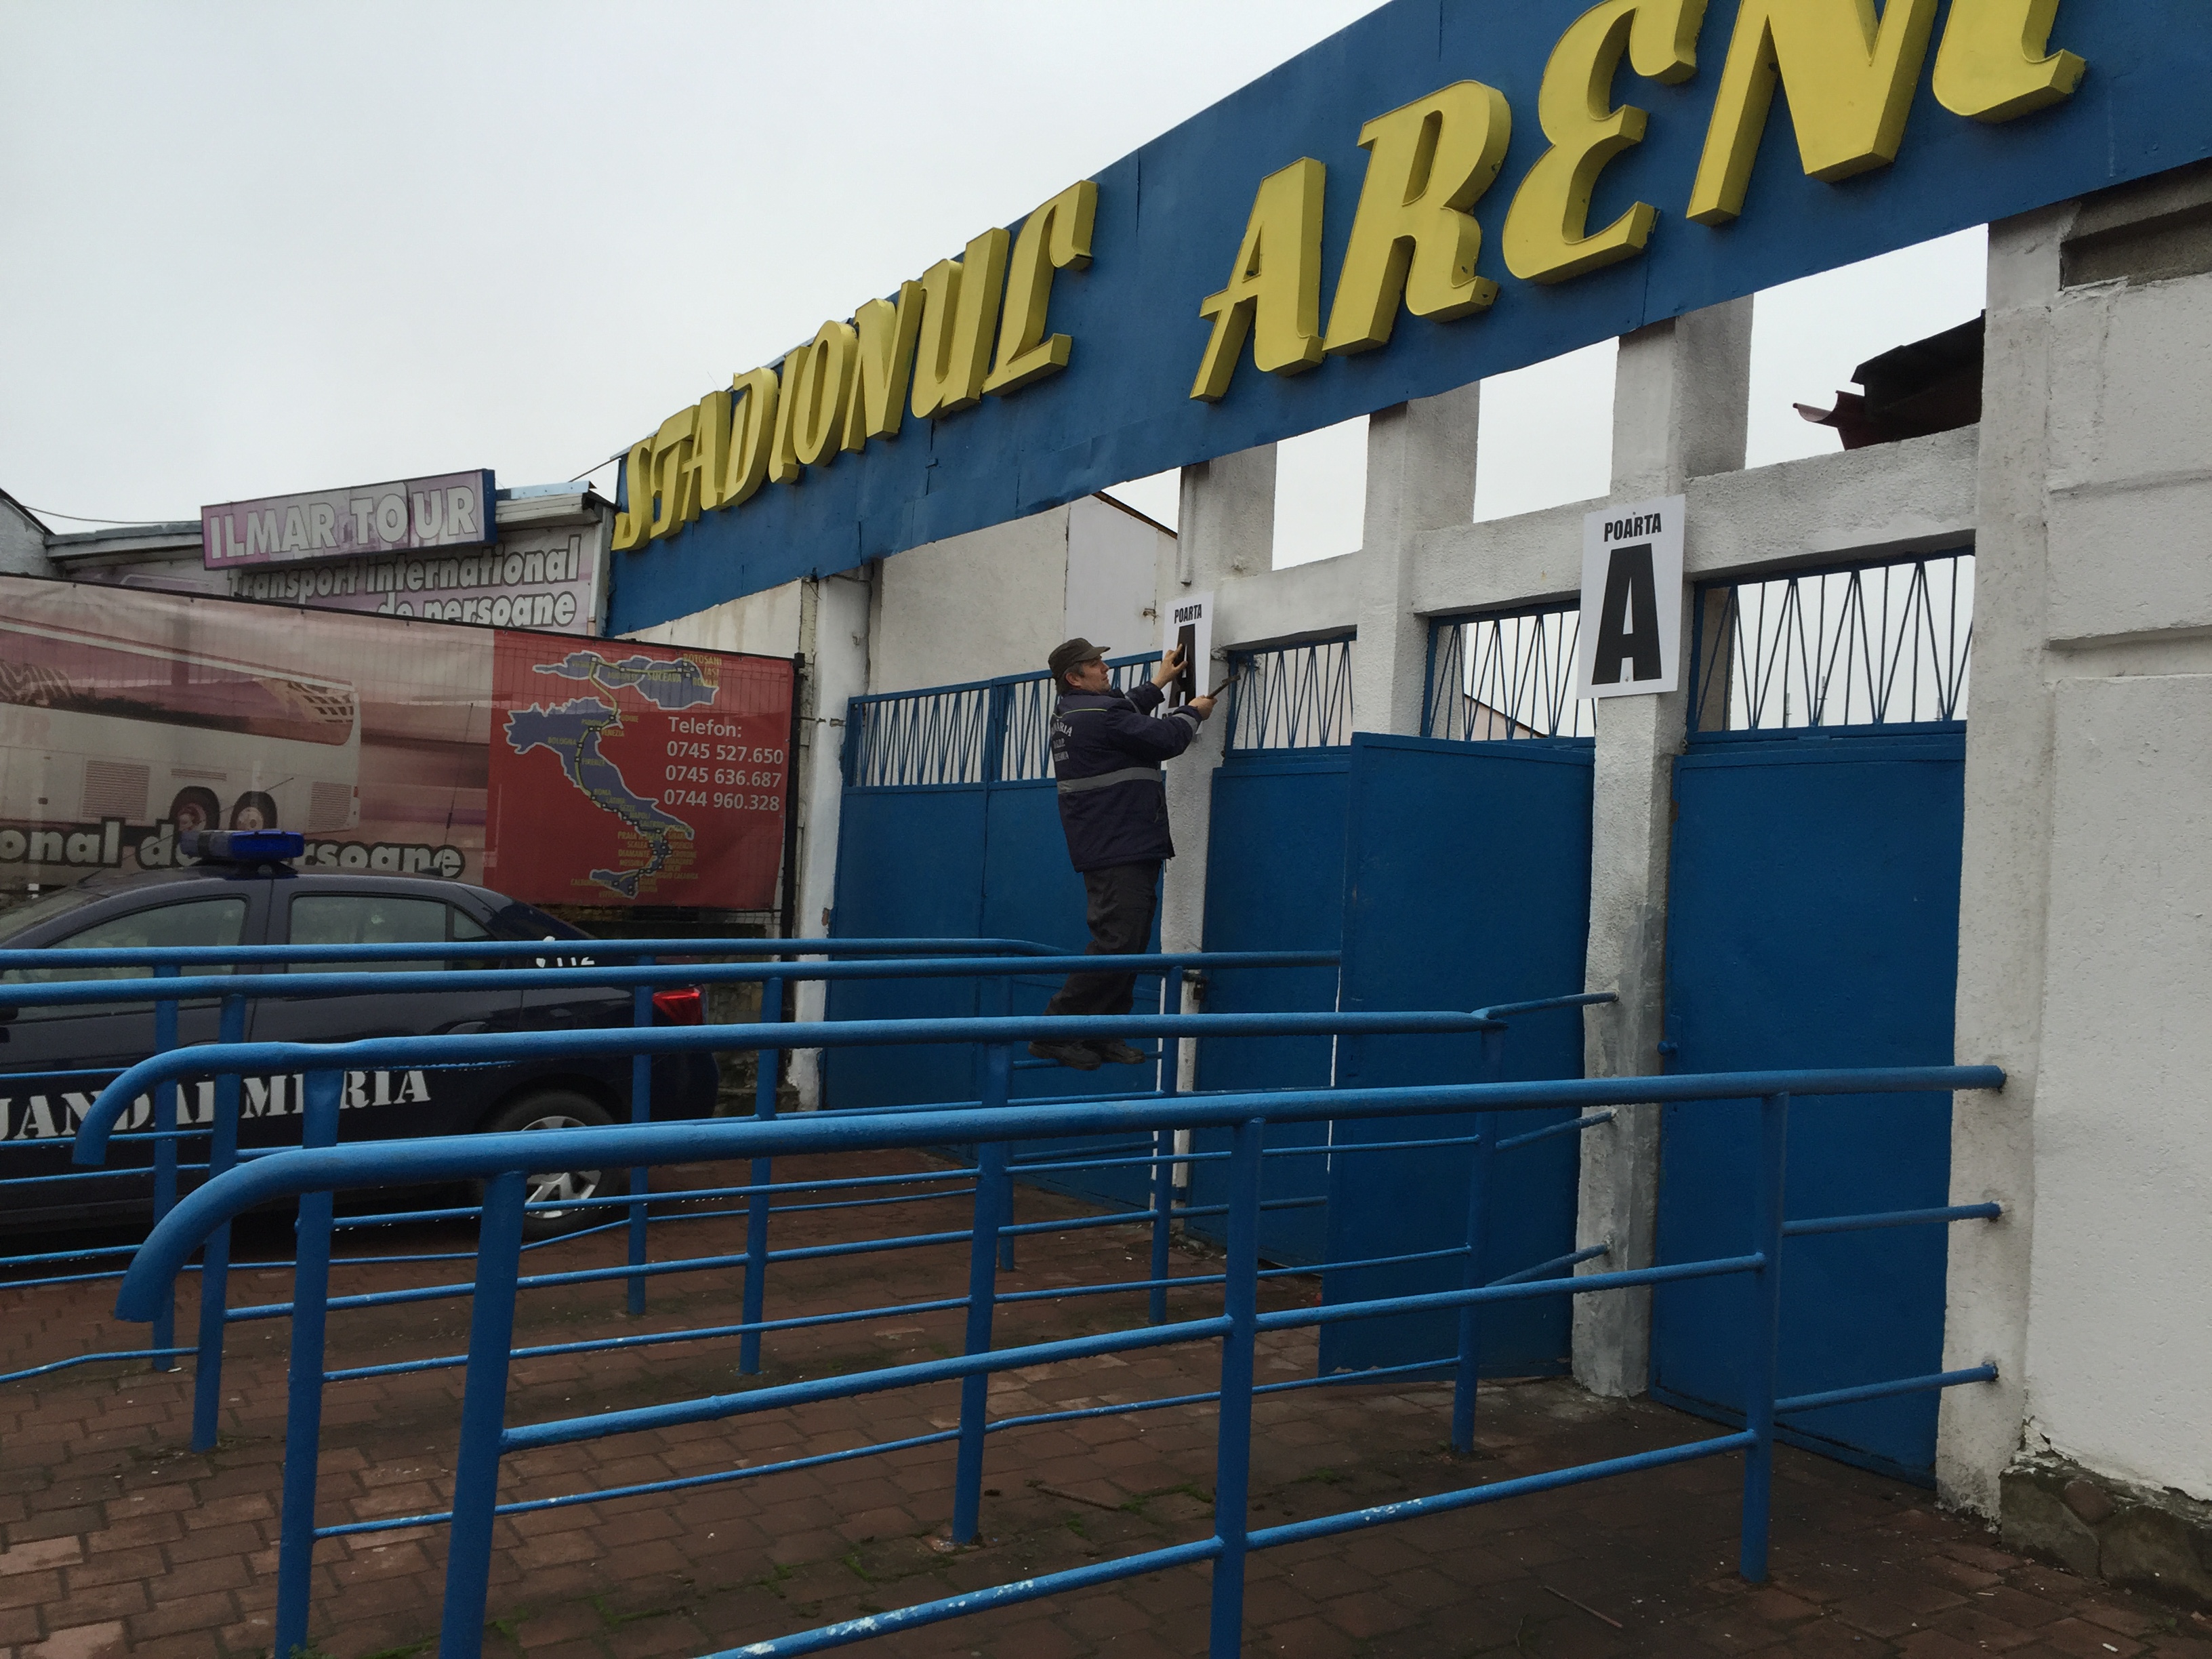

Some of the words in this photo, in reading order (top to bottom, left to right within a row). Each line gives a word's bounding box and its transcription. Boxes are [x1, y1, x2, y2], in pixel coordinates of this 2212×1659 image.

[611, 180, 1099, 552] STADIONUL
[209, 502, 340, 560] ILMAR
[350, 485, 478, 546] TOUR
[1603, 513, 1662, 542] POARTA
[366, 535, 581, 593] international
[1174, 604, 1202, 624] POARTA
[1591, 543, 1662, 685] A
[668, 716, 742, 738] Telefon:
[666, 741, 710, 759] 0745
[716, 744, 784, 764] 527.650
[665, 764, 709, 783] 0745
[714, 768, 782, 787] 636.687
[663, 789, 708, 807] 0744
[713, 792, 780, 811] 960.328
[292, 843, 462, 878] rsoane
[0, 1070, 431, 1141] JANDAMRIA
